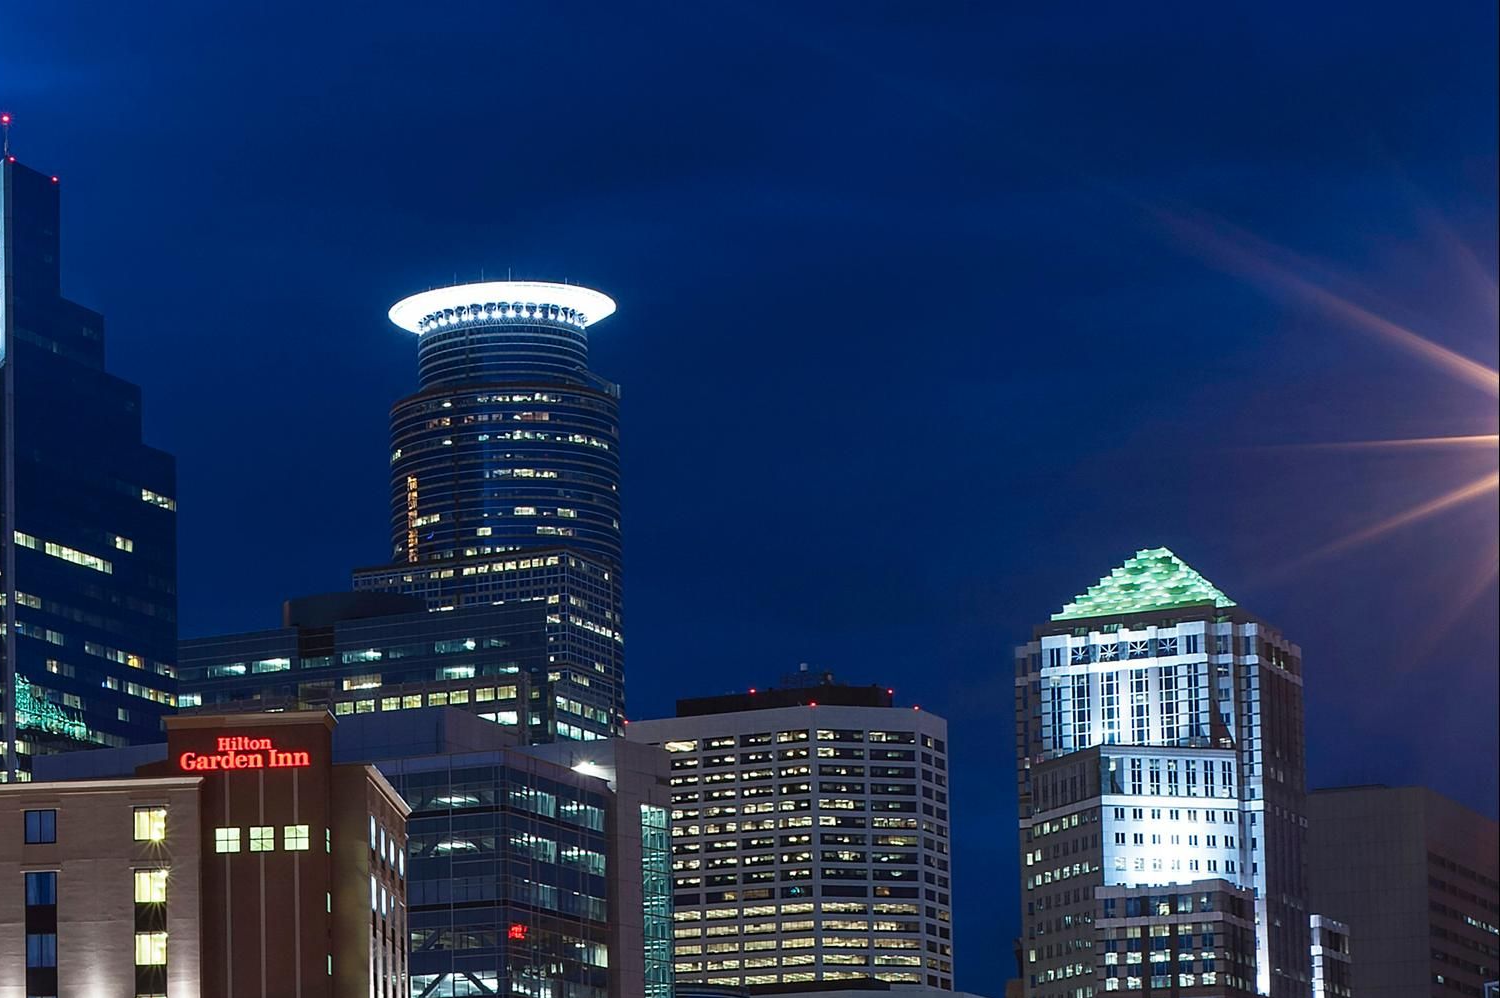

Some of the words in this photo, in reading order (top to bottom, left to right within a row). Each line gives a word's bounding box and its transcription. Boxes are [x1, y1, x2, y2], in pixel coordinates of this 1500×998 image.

[217, 736, 272, 752] Hilton
[180, 750, 264, 771] Garden
[268, 749, 310, 768] Inn
